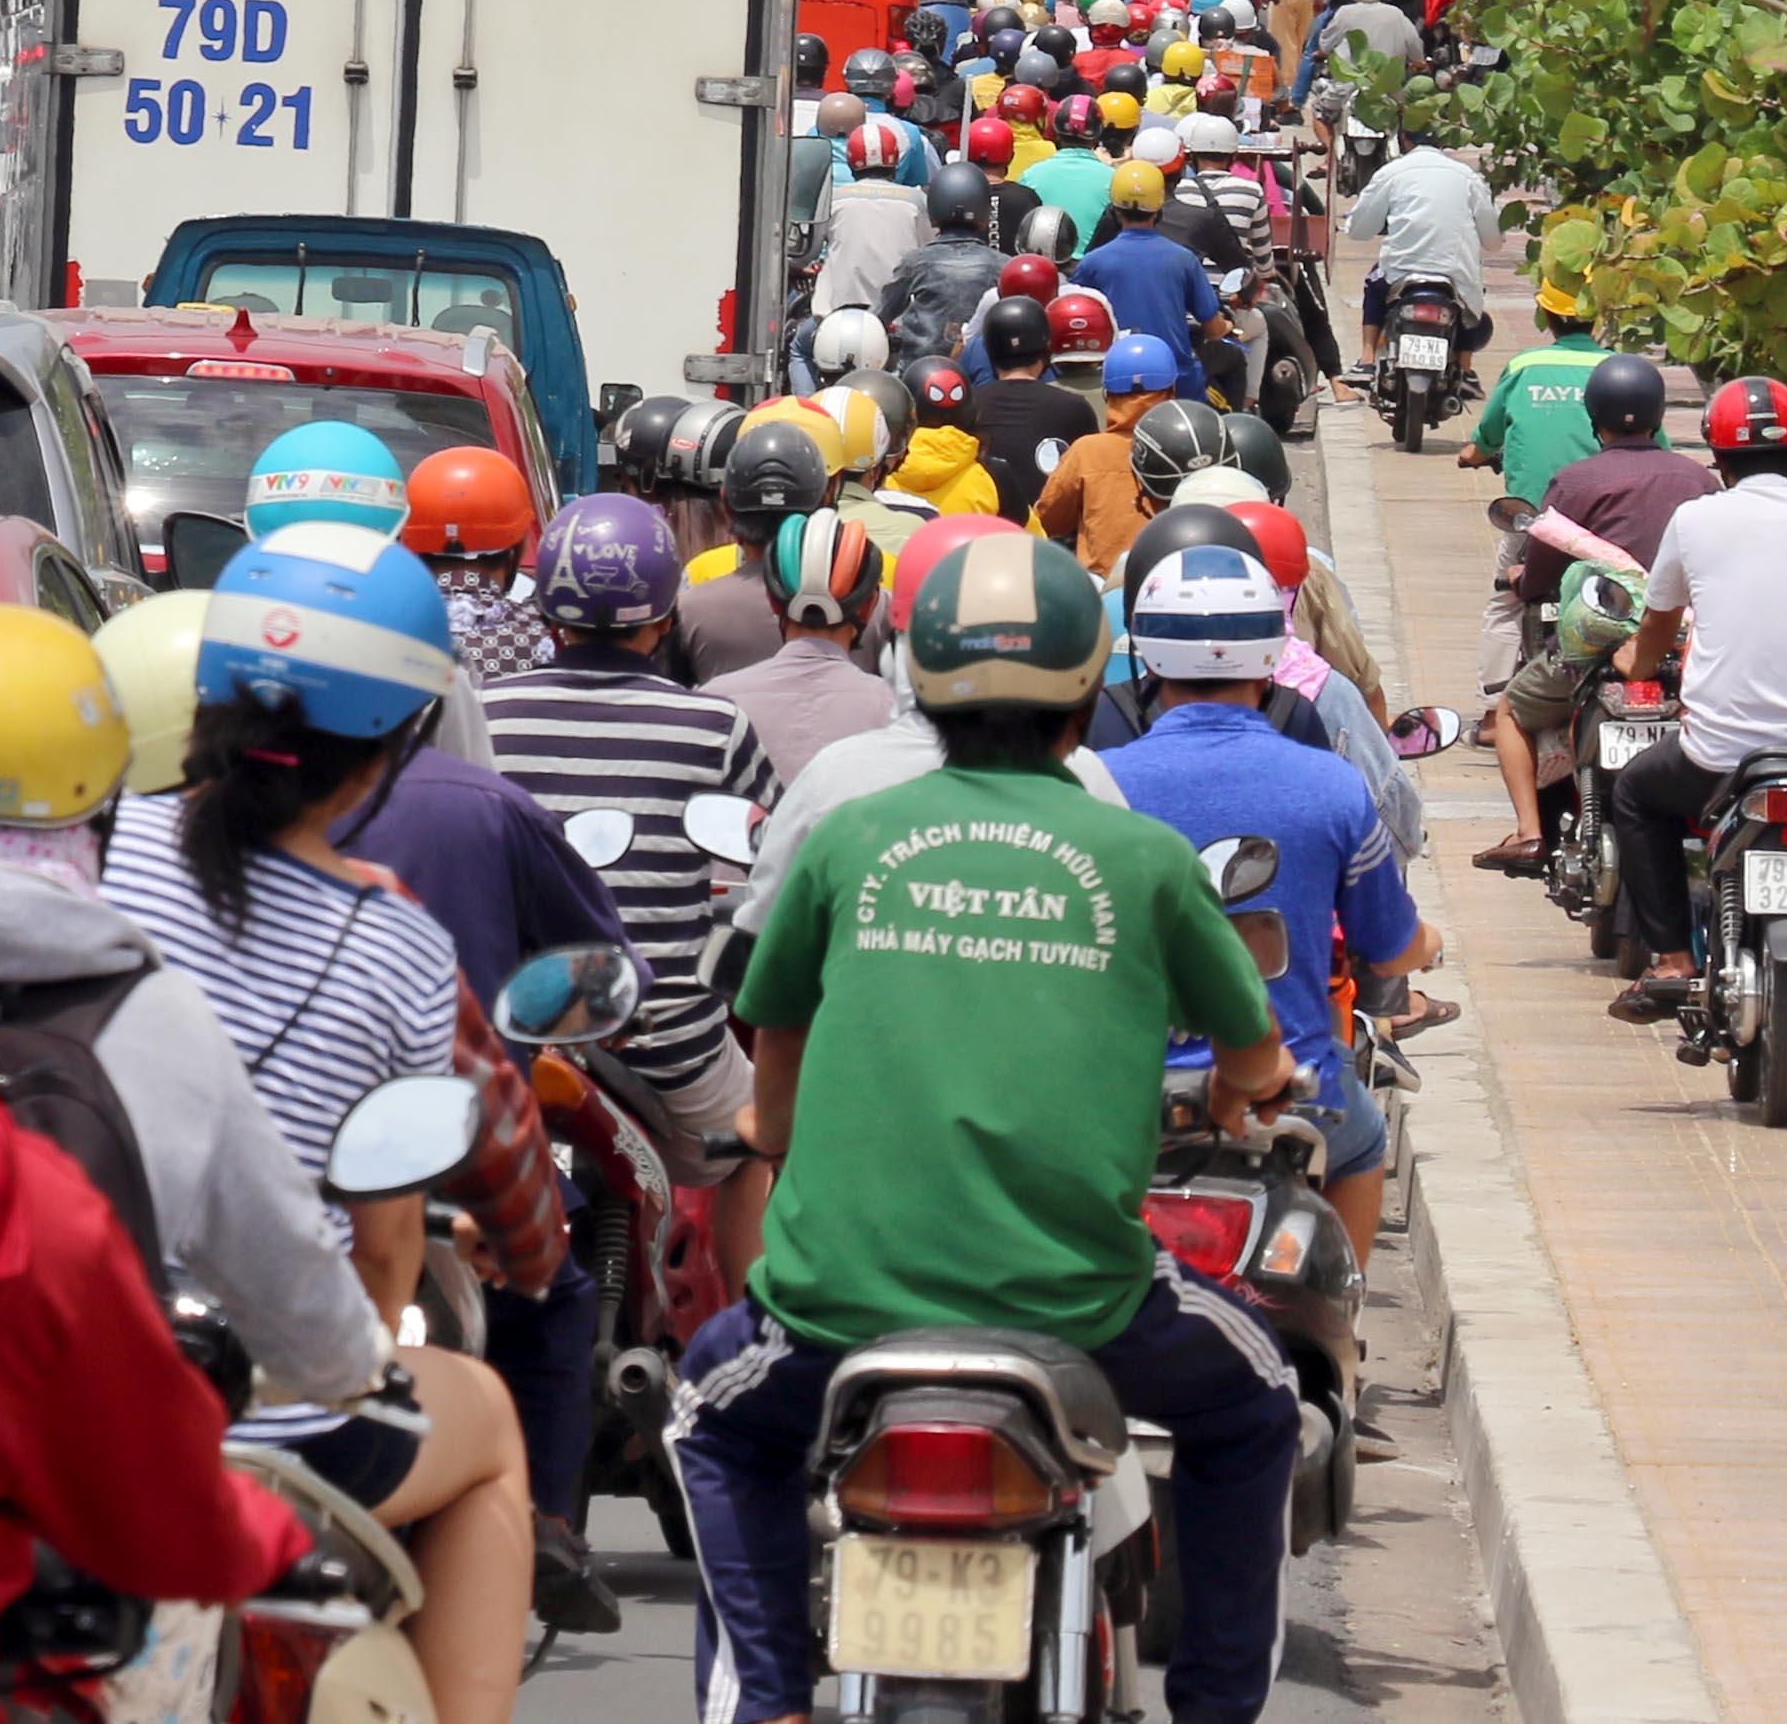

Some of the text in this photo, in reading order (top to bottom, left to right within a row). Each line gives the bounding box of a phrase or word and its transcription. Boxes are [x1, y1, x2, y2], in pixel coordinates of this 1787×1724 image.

[879, 821, 963, 869] TRÁCH
[968, 821, 1054, 854] NHIỆM
[907, 878, 1068, 922] VIỆT TÂN
[903, 926, 949, 956] MÁY
[956, 932, 1023, 964] GẠCH
[1028, 941, 1112, 973] TUYNET
[862, 1544, 1005, 1606] 79-K3
[862, 1610, 1000, 1665] 9985
